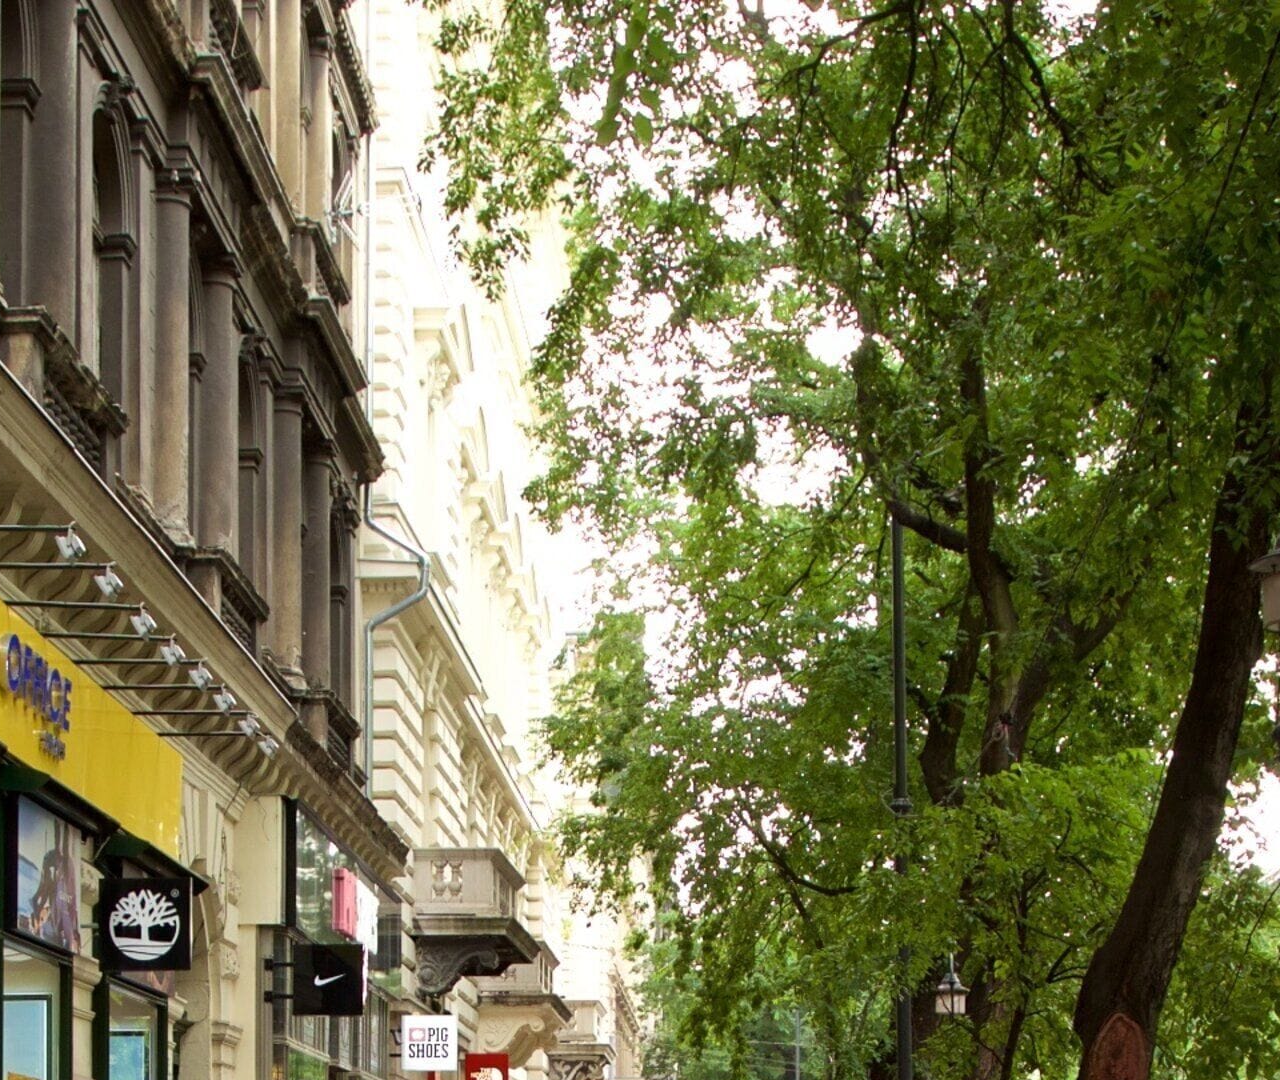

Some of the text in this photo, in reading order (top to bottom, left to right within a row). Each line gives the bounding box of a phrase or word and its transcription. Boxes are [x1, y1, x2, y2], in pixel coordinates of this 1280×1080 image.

[4, 633, 72, 733] OFFICE
[427, 1028, 449, 1042] PIG
[408, 1044, 449, 1058] SHOES
